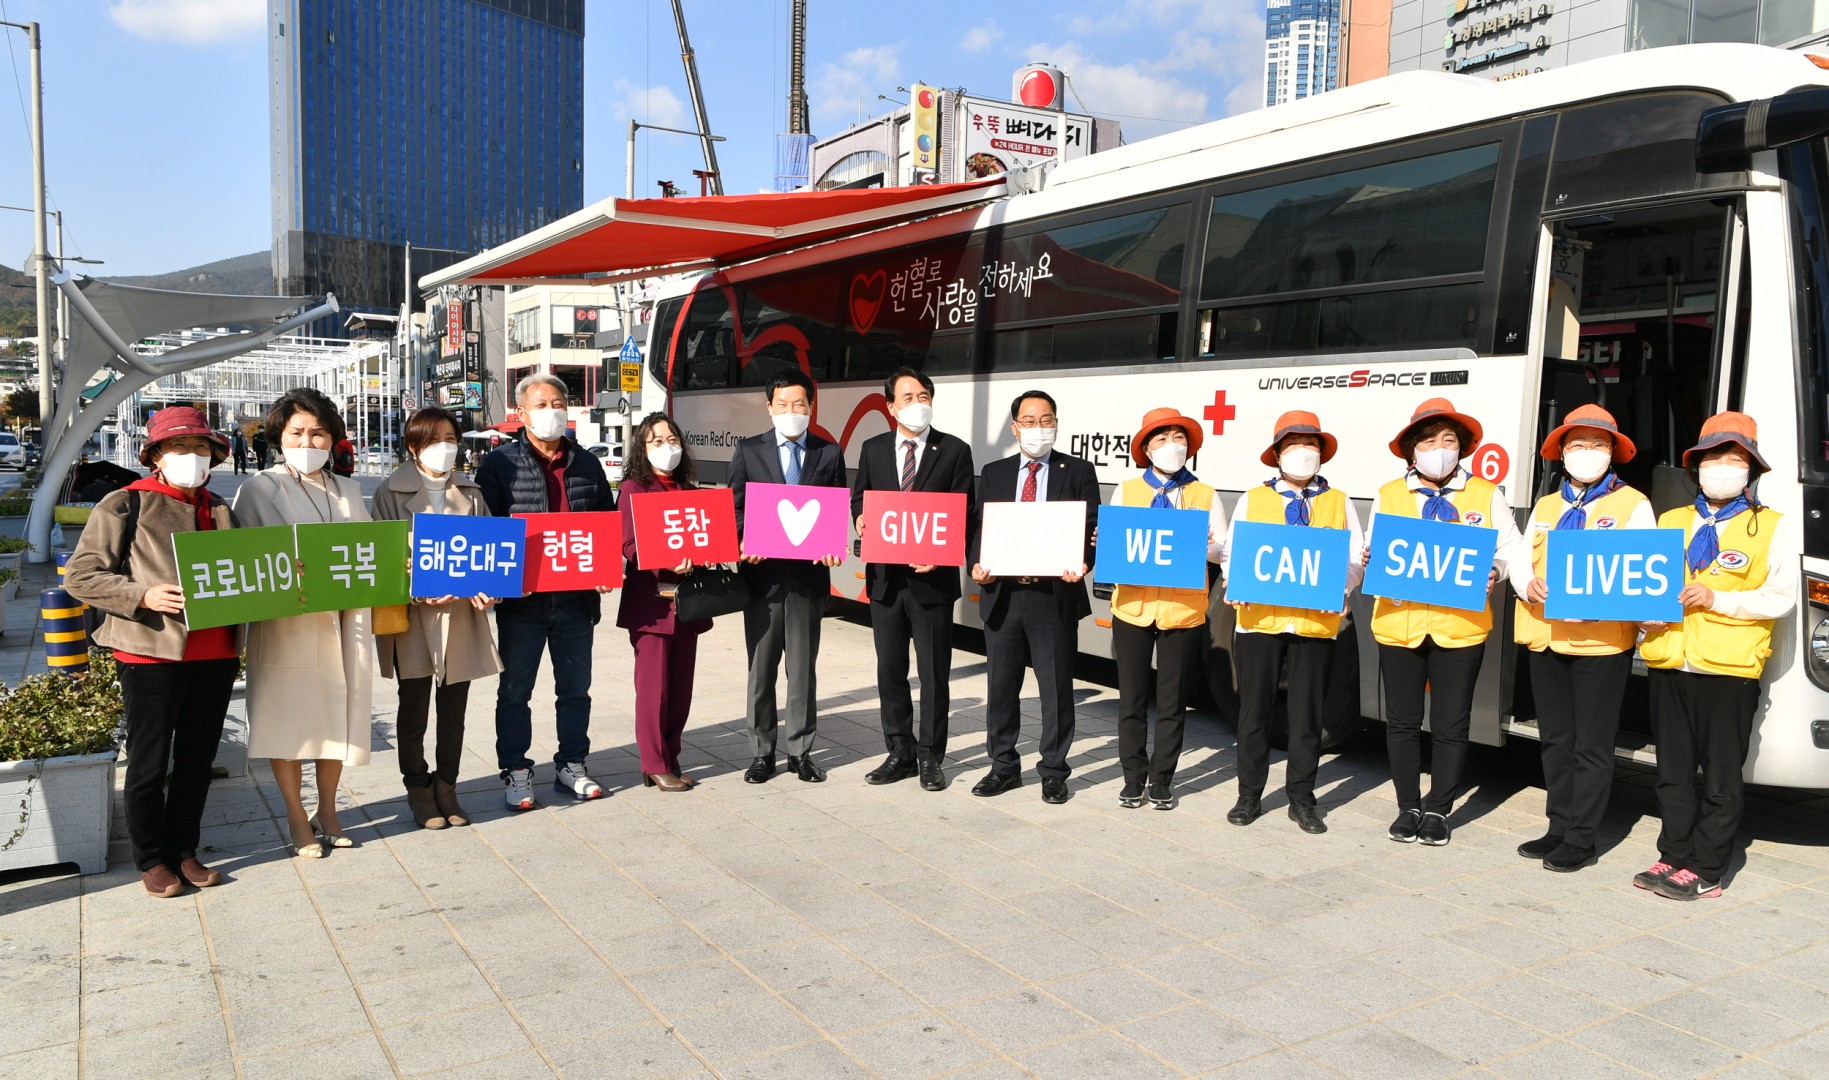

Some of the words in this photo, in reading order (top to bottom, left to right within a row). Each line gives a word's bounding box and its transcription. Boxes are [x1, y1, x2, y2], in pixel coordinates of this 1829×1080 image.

[1008, 142, 1024, 152] HOUR
[890, 257, 942, 312] 헌혈로
[919, 278, 978, 329] 사랑을
[979, 252, 1053, 298] 전하세요
[710, 430, 725, 447] Red
[1481, 449, 1501, 480] 6
[663, 506, 711, 550] 동참
[880, 510, 948, 546] GIVE
[1125, 528, 1174, 566] WE
[329, 541, 377, 589] 극복
[419, 534, 517, 578] 해운대구
[542, 529, 594, 572] 헌혈
[1254, 545, 1321, 587] CAN
[1385, 538, 1478, 587] SAVE
[191, 551, 293, 600] 코로나19
[1565, 553, 1669, 596] LIVES
